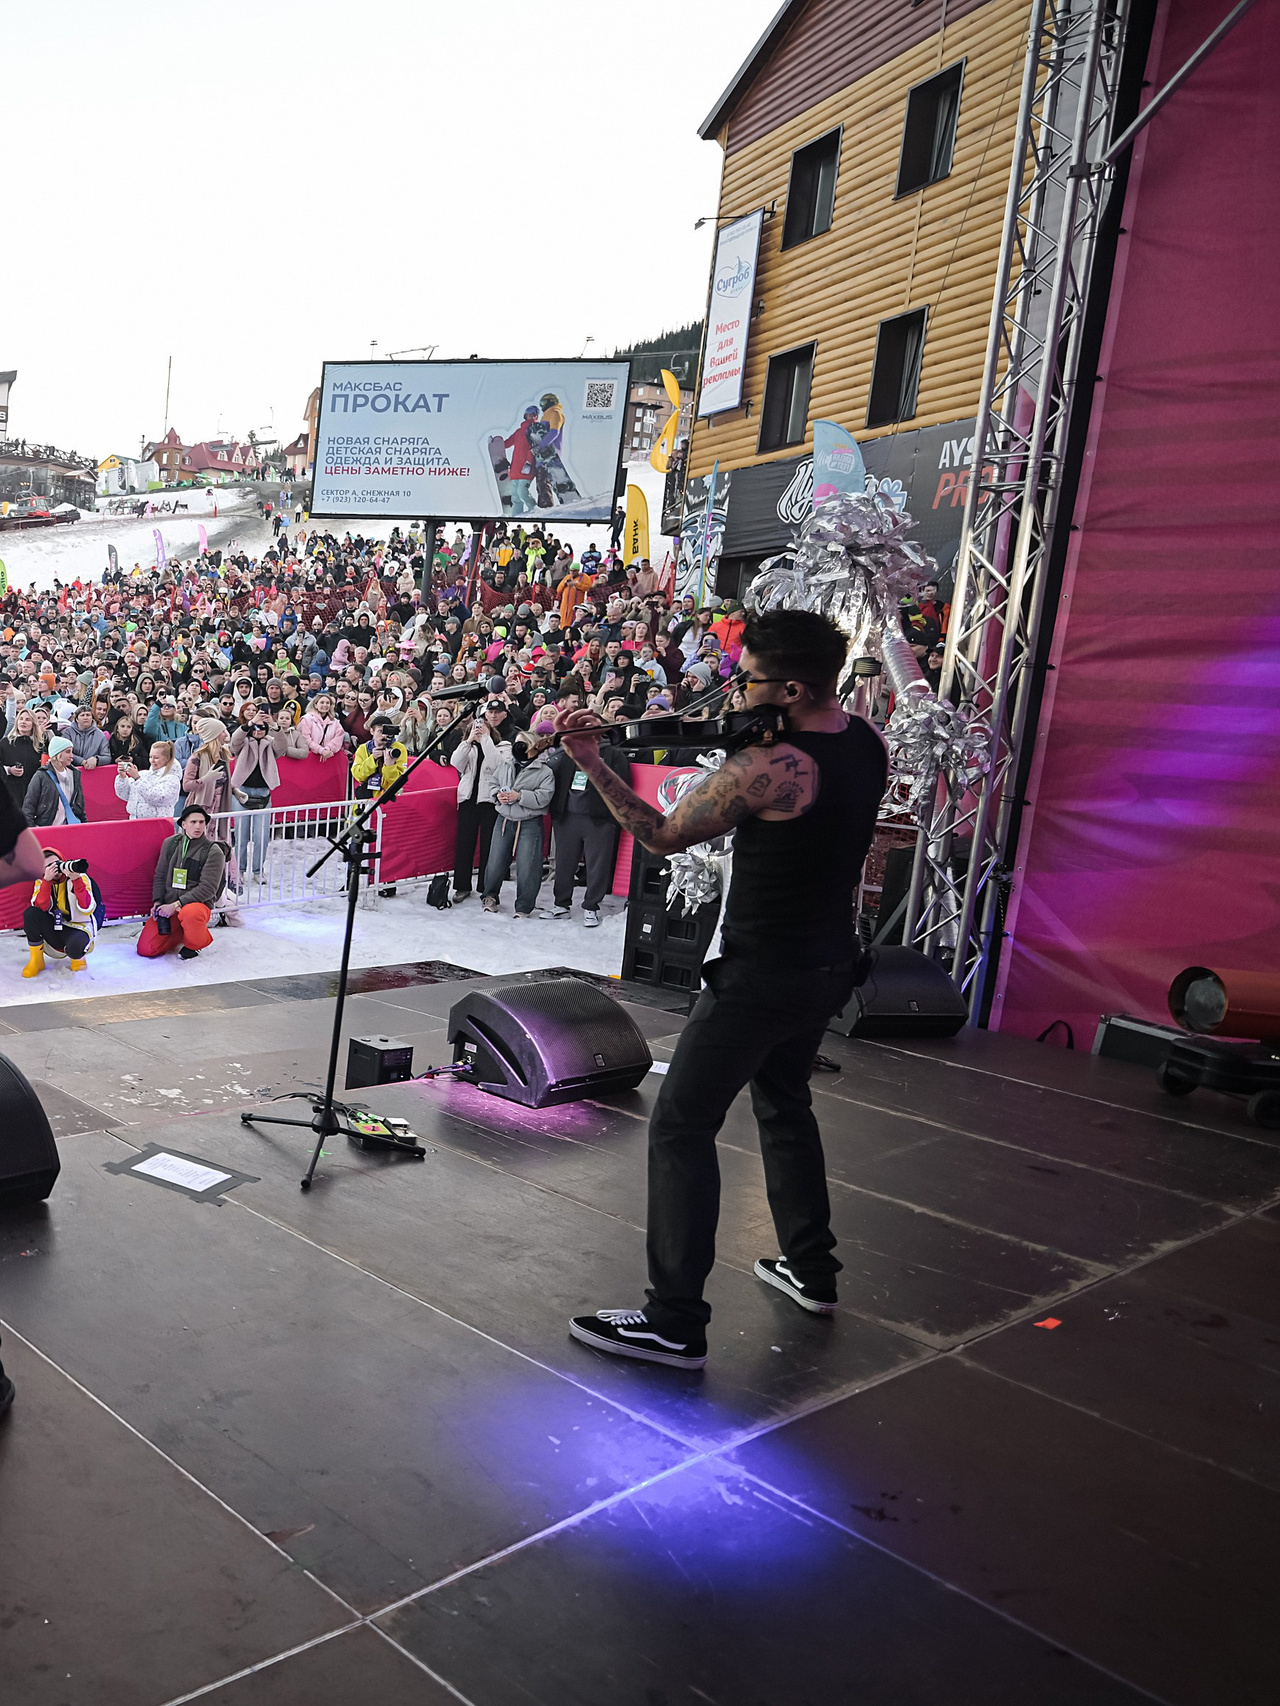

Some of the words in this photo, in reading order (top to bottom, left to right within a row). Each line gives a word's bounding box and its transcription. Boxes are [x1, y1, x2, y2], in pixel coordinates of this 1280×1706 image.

[717, 266, 750, 292] Сугроб
[715, 319, 740, 335] Место
[717, 337, 734, 352] для
[710, 348, 739, 368] Вашей
[702, 366, 741, 389] рекламы
[332, 380, 403, 392] МАКСБАС
[330, 393, 450, 413] ПРОКАТ
[327, 436, 370, 446] НОВАЯ
[373, 436, 430, 446] СНАРЯГА
[325, 446, 382, 456] ДЕТСКАЯ
[385, 446, 442, 456] СНАРЯГА
[325, 456, 380, 466] ОДЕЖДА
[384, 456, 393, 466] И
[396, 456, 451, 467] ЗАЩИТА
[324, 466, 361, 476] ЦЕНЫ
[364, 466, 425, 476] ЗАМЕТНО
[428, 467, 471, 477] НИЖЕ!
[351, 489, 359, 497] А,
[360, 489, 400, 497] СНЕЖНАЯ
[332, 496, 351, 504] (923)
[354, 496, 391, 504] 120-64-47
